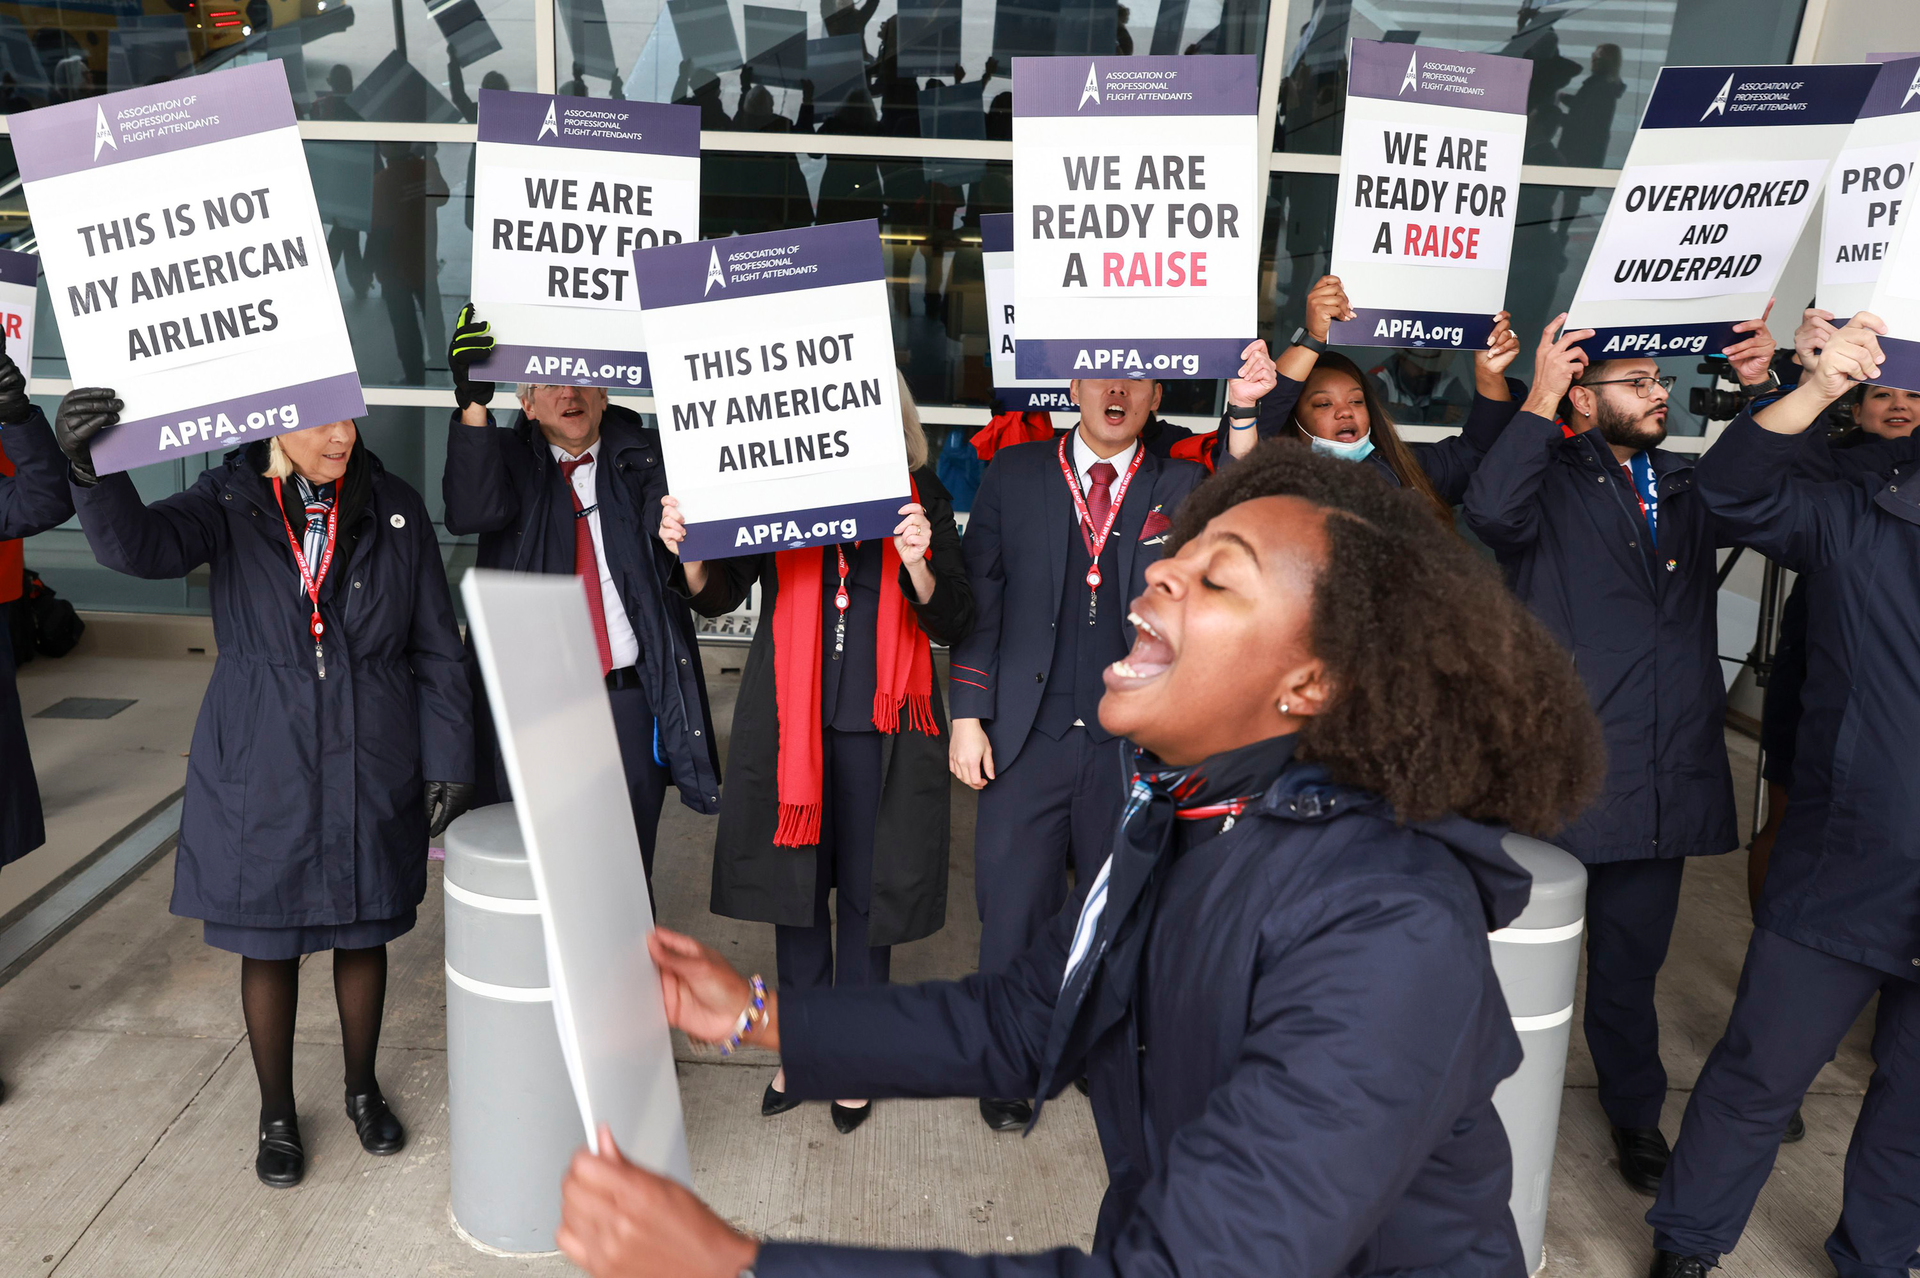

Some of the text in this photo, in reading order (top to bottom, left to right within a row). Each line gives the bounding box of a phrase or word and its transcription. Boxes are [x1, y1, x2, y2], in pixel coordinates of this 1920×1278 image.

[1422, 72, 1468, 83] PROFESSIONAL
[1423, 62, 1465, 73] ASSOCIATION
[1422, 82, 1484, 95] FLIGHT ATTENDANTS
[1734, 93, 1790, 101] PROFESSIONAL
[117, 95, 196, 119] ASSOCIATION OF
[120, 110, 190, 131] PROFESSIONAL
[564, 110, 616, 120] ASSOCIATION
[123, 116, 219, 143] FLIGHT ATTENDANTS
[564, 119, 620, 130] PROFESSIONAL
[592, 130, 642, 140] ATTENDANTS
[1384, 131, 1487, 171] WE ARE
[1063, 156, 1205, 190] WE ARE
[525, 178, 652, 216] WE ARE
[1355, 175, 1506, 217] READY FOR
[1626, 180, 1809, 212] OVERWORKED
[77, 188, 269, 257] THIS IS NOT
[1033, 203, 1239, 239] READY FOR
[1679, 224, 1728, 245] AND
[493, 219, 607, 255] READY
[1373, 222, 1480, 259] A RAISE
[728, 245, 799, 261] ASSOCIATION OF
[730, 258, 792, 272] PROFESSIONAL
[1836, 242, 1889, 263] AME
[68, 237, 308, 316] MY AMERICAN
[732, 265, 817, 282] FLIGHT ATTENDANTS
[1063, 251, 1206, 287] A RAISE
[1614, 254, 1762, 283] UNDERPAID
[549, 266, 628, 301] REST
[129, 299, 278, 361] AIRLINES
[1374, 319, 1463, 345] APFA.org
[1603, 334, 1708, 352] APFA.org
[525, 356, 641, 385] APFA.org
[684, 334, 853, 381] THIS IS NOT
[1074, 350, 1198, 375] APFA.org
[672, 379, 881, 431] MY AMERICAN
[1028, 393, 1080, 407] APFA.
[159, 404, 299, 450] APFA.org
[719, 430, 849, 472] AIRLINES
[735, 519, 856, 547] APFA.org
